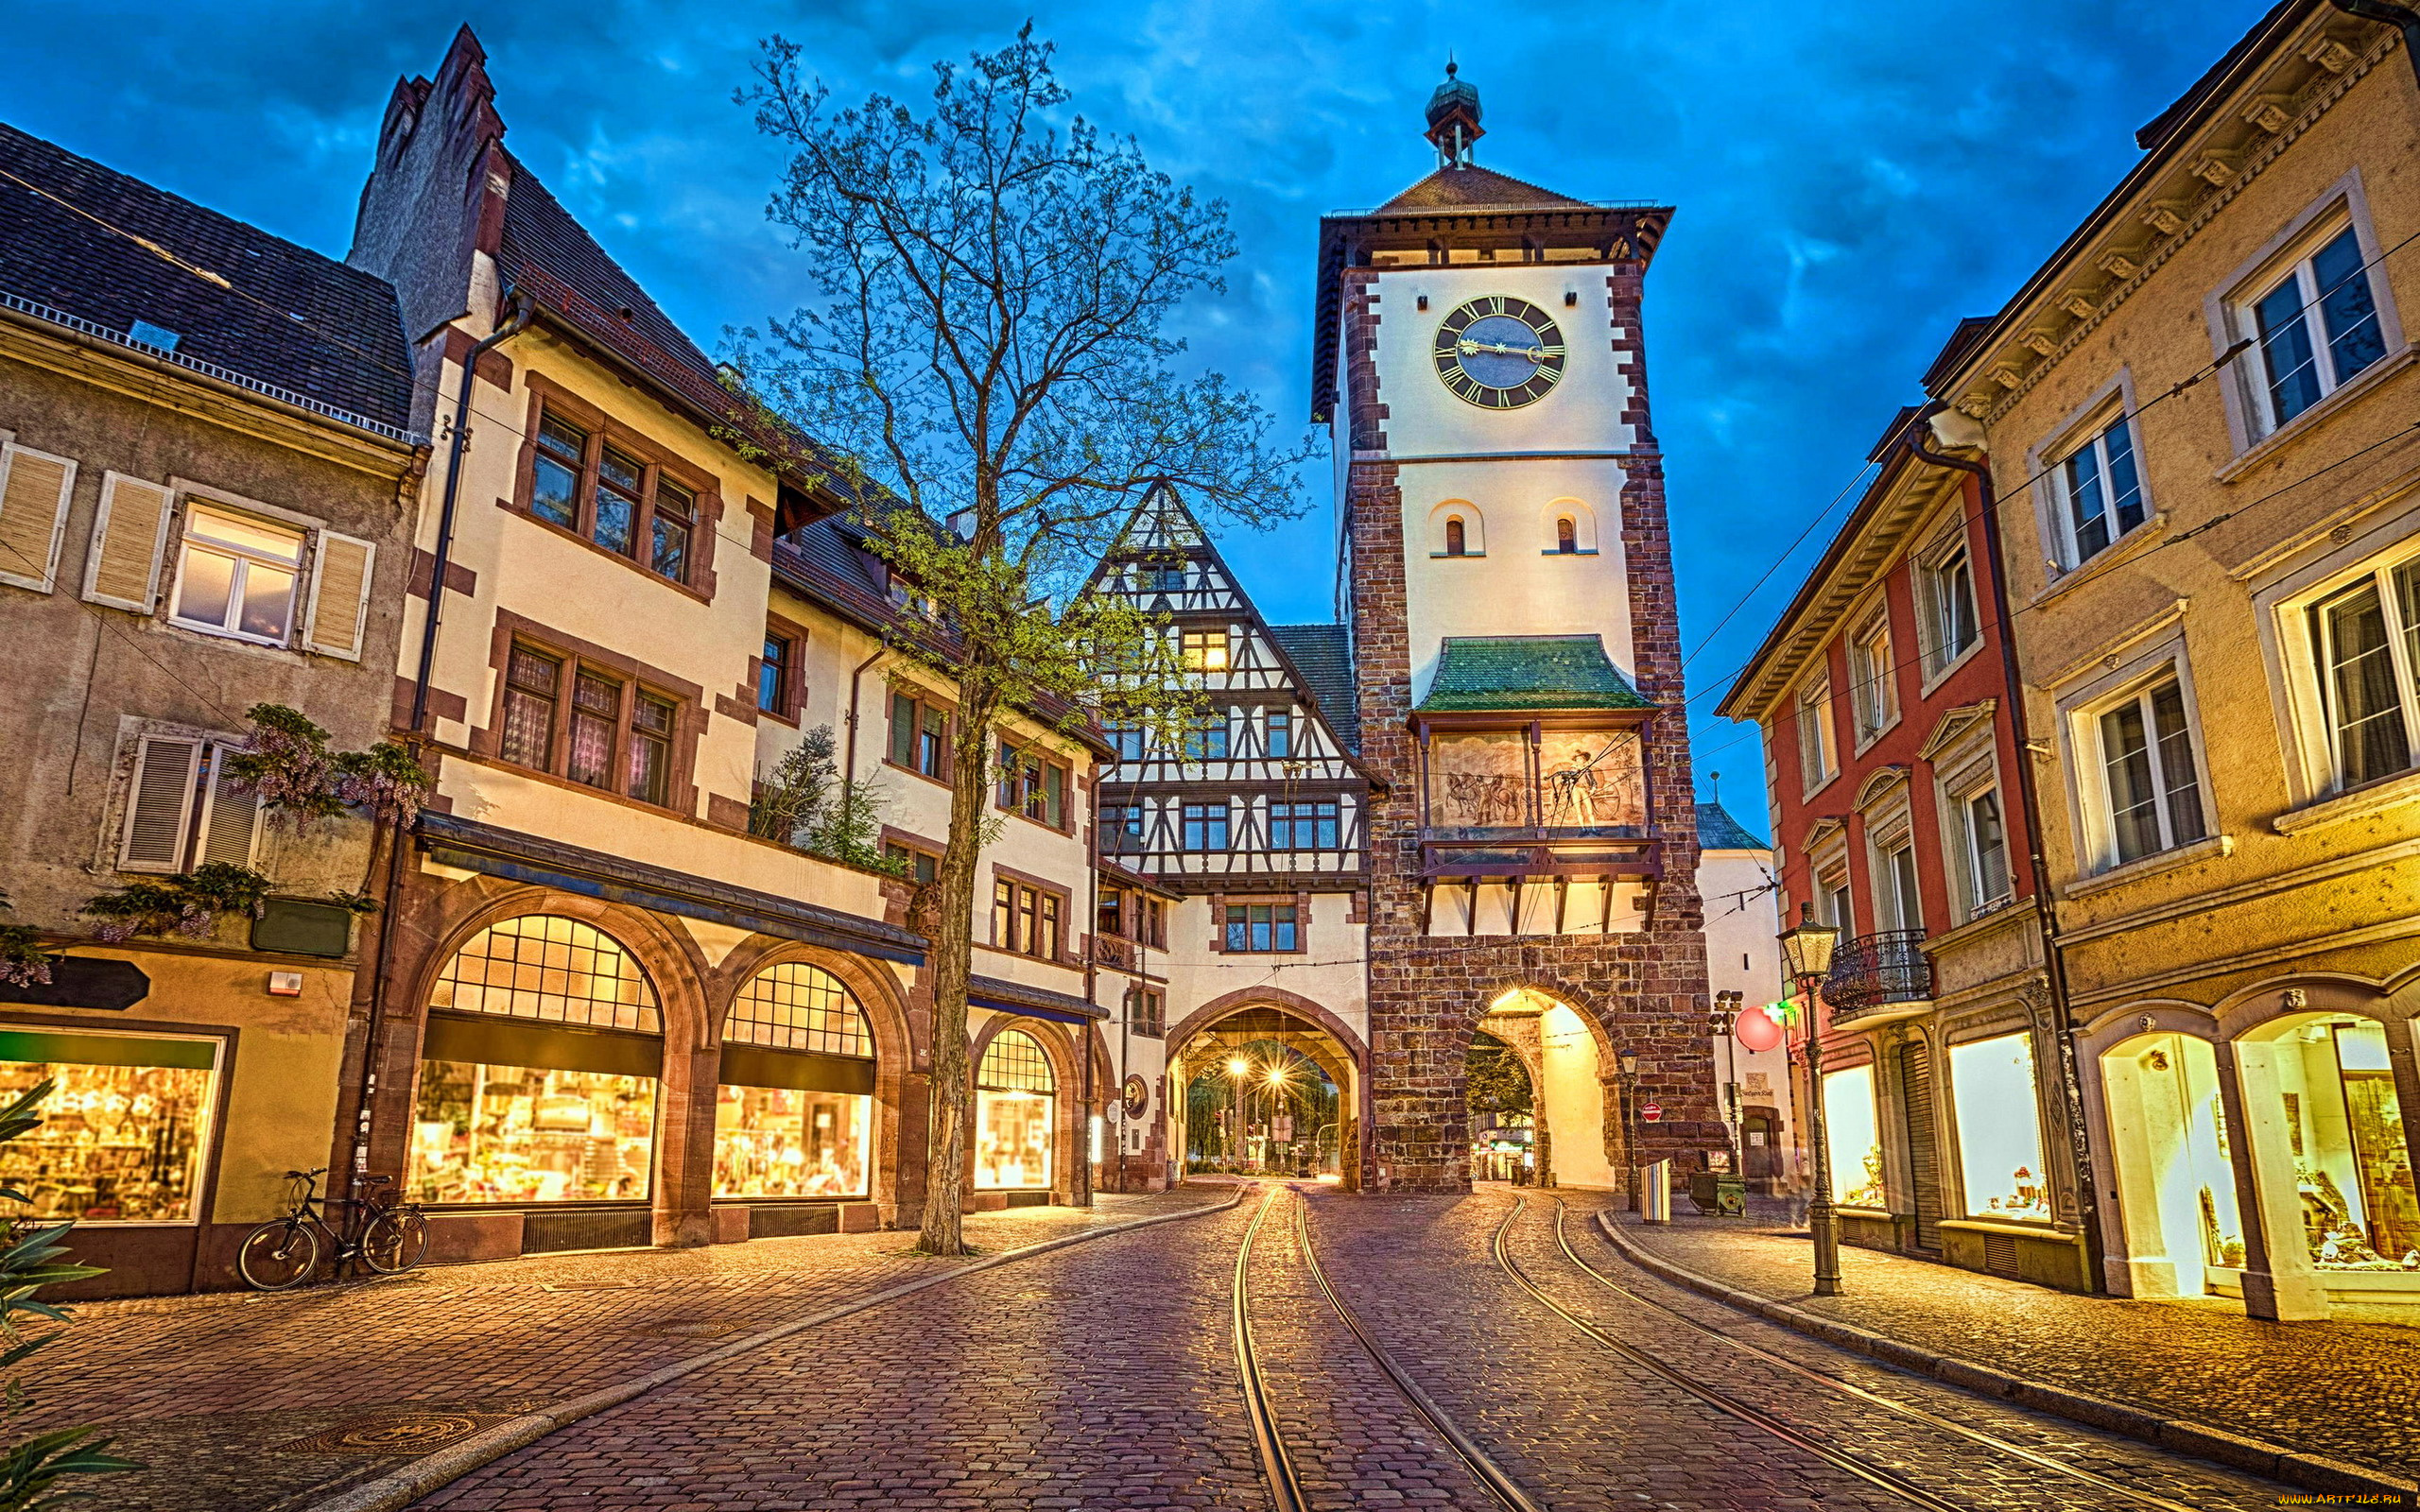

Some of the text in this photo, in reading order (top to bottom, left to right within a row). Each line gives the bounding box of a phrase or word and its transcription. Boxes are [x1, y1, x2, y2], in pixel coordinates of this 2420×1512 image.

[1460, 302, 1480, 322] XI
[1488, 297, 1505, 315] XII
[1519, 303, 1530, 318] I
[1441, 321, 1462, 336] X
[1535, 319, 1555, 335] II
[1435, 346, 1457, 358] IX
[1441, 365, 1466, 387] VIII
[1463, 382, 1483, 404] VII
[1497, 389, 1511, 407] VI
[1524, 384, 1538, 402] V
